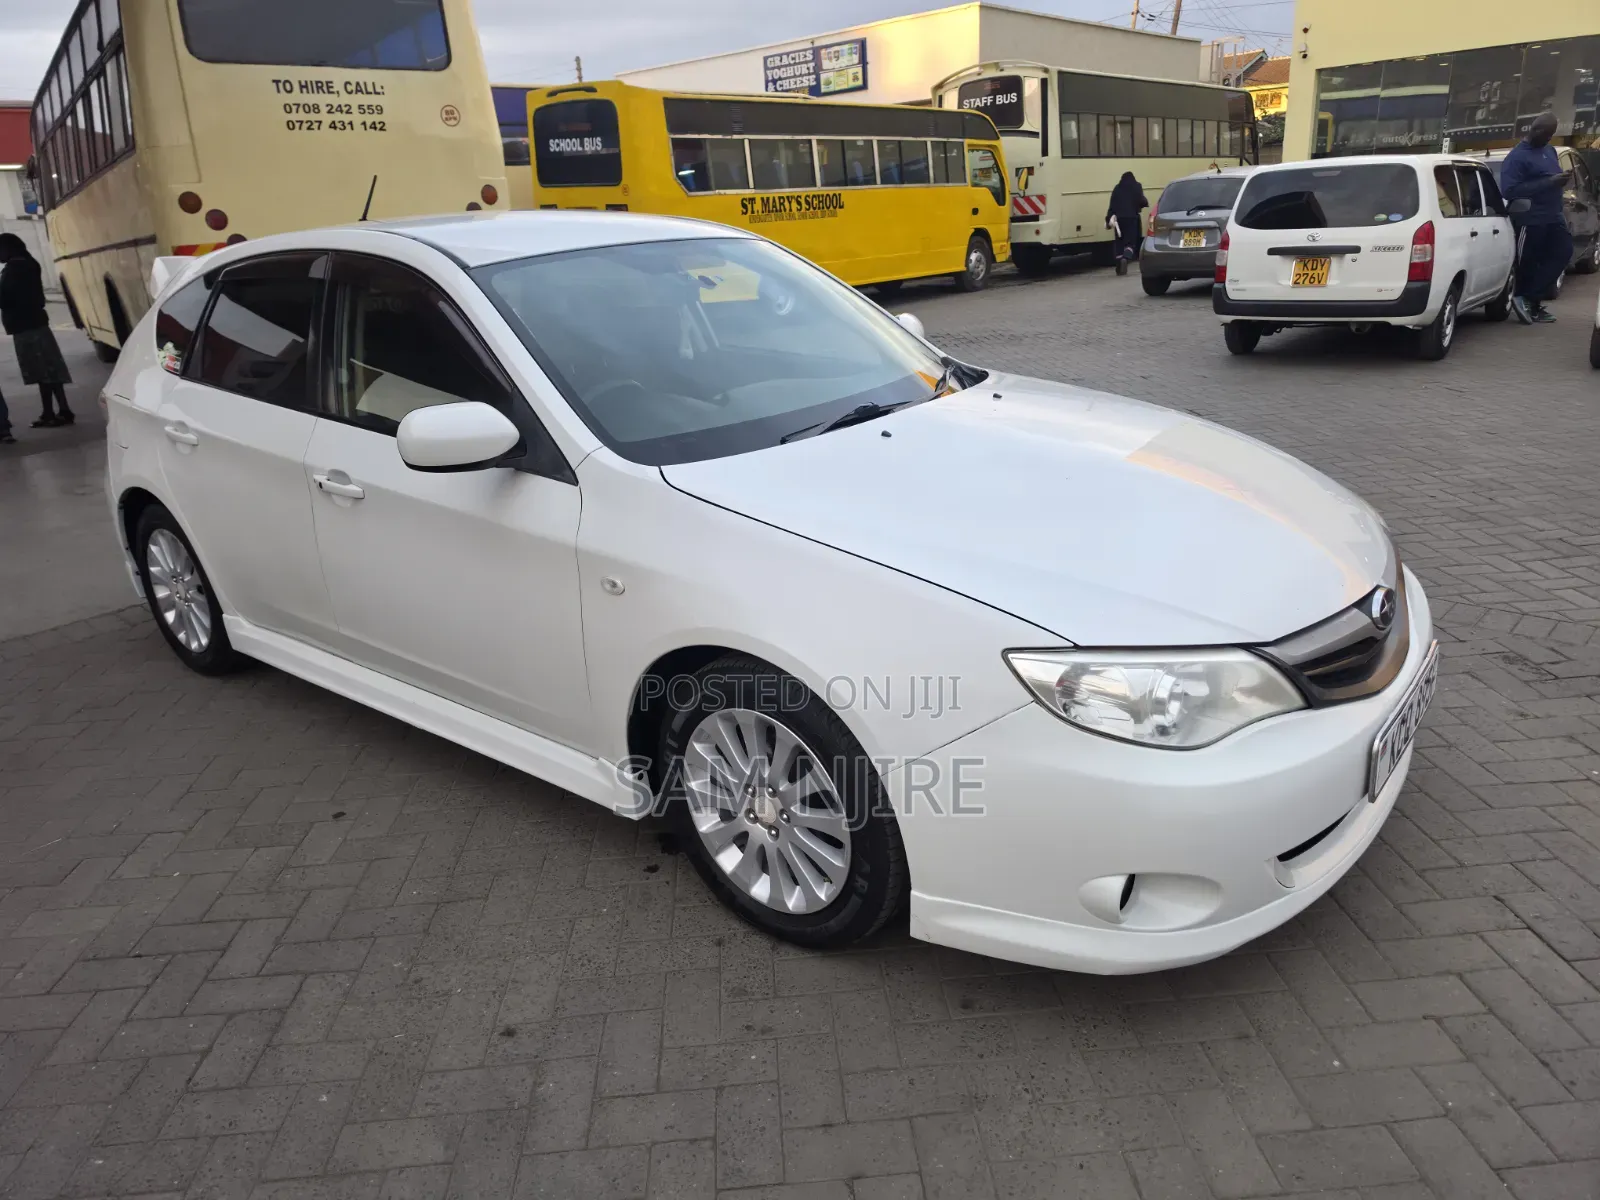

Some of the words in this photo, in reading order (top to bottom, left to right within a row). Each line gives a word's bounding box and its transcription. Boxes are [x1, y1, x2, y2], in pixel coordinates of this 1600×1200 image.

[766, 49, 813, 67] GRACIES
[766, 62, 816, 80] YOGHURT
[272, 79, 294, 94] TO
[298, 80, 340, 97] HIRE,
[343, 81, 385, 95] CALL:
[767, 81, 776, 92] &
[776, 75, 817, 91] CHEESE
[283, 103, 321, 114] 0708
[325, 103, 353, 114] 242
[357, 104, 384, 115] 559
[963, 95, 994, 109] STAFF
[995, 92, 1018, 105] BUS
[286, 119, 323, 131] 0727
[328, 120, 355, 131] 431
[360, 121, 387, 131] 142
[549, 138, 583, 152] SCHOOL
[584, 137, 602, 151] BUS
[741, 197, 760, 215] ST.
[760, 195, 803, 213] MARY'S
[804, 193, 845, 211] SCHOOL
[1302, 258, 1327, 271] KDY
[1294, 272, 1325, 285] 276V
